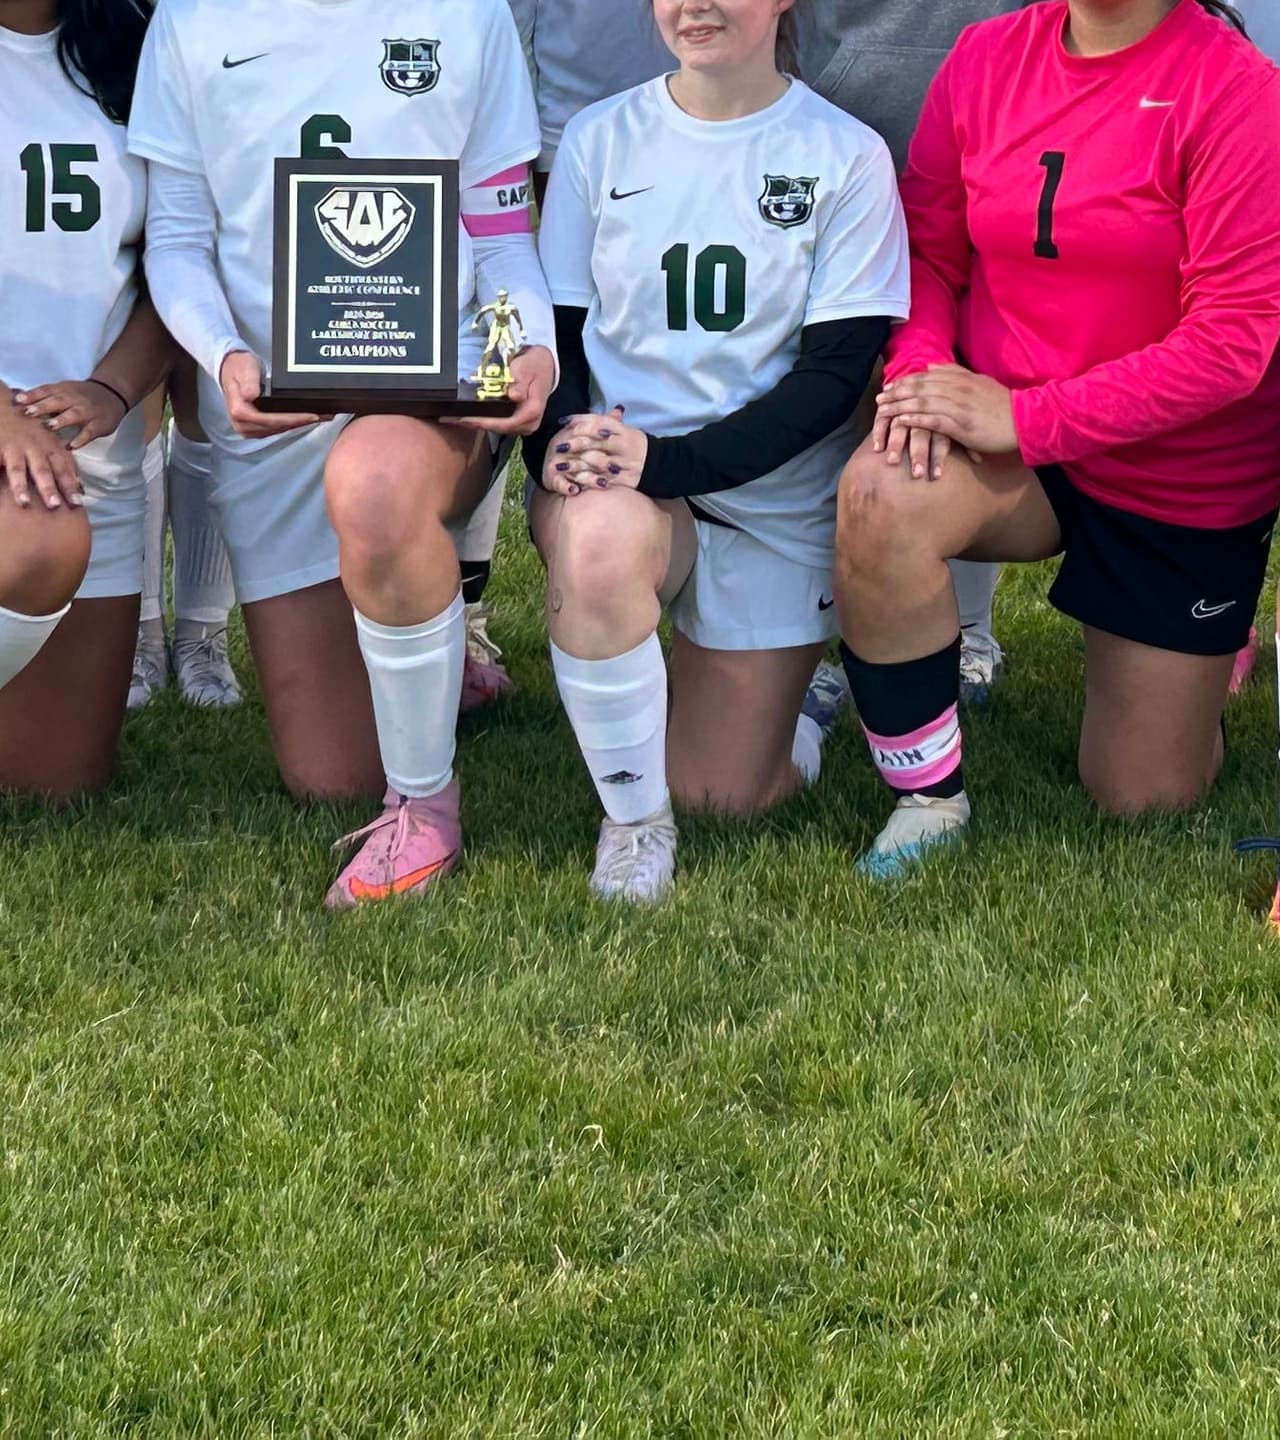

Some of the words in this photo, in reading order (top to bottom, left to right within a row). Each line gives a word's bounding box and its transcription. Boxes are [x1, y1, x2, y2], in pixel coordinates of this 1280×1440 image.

[19, 143, 101, 233] 15
[1032, 151, 1066, 261] 1
[661, 243, 747, 333] 10
[319, 344, 408, 358] CHAMPIONS
